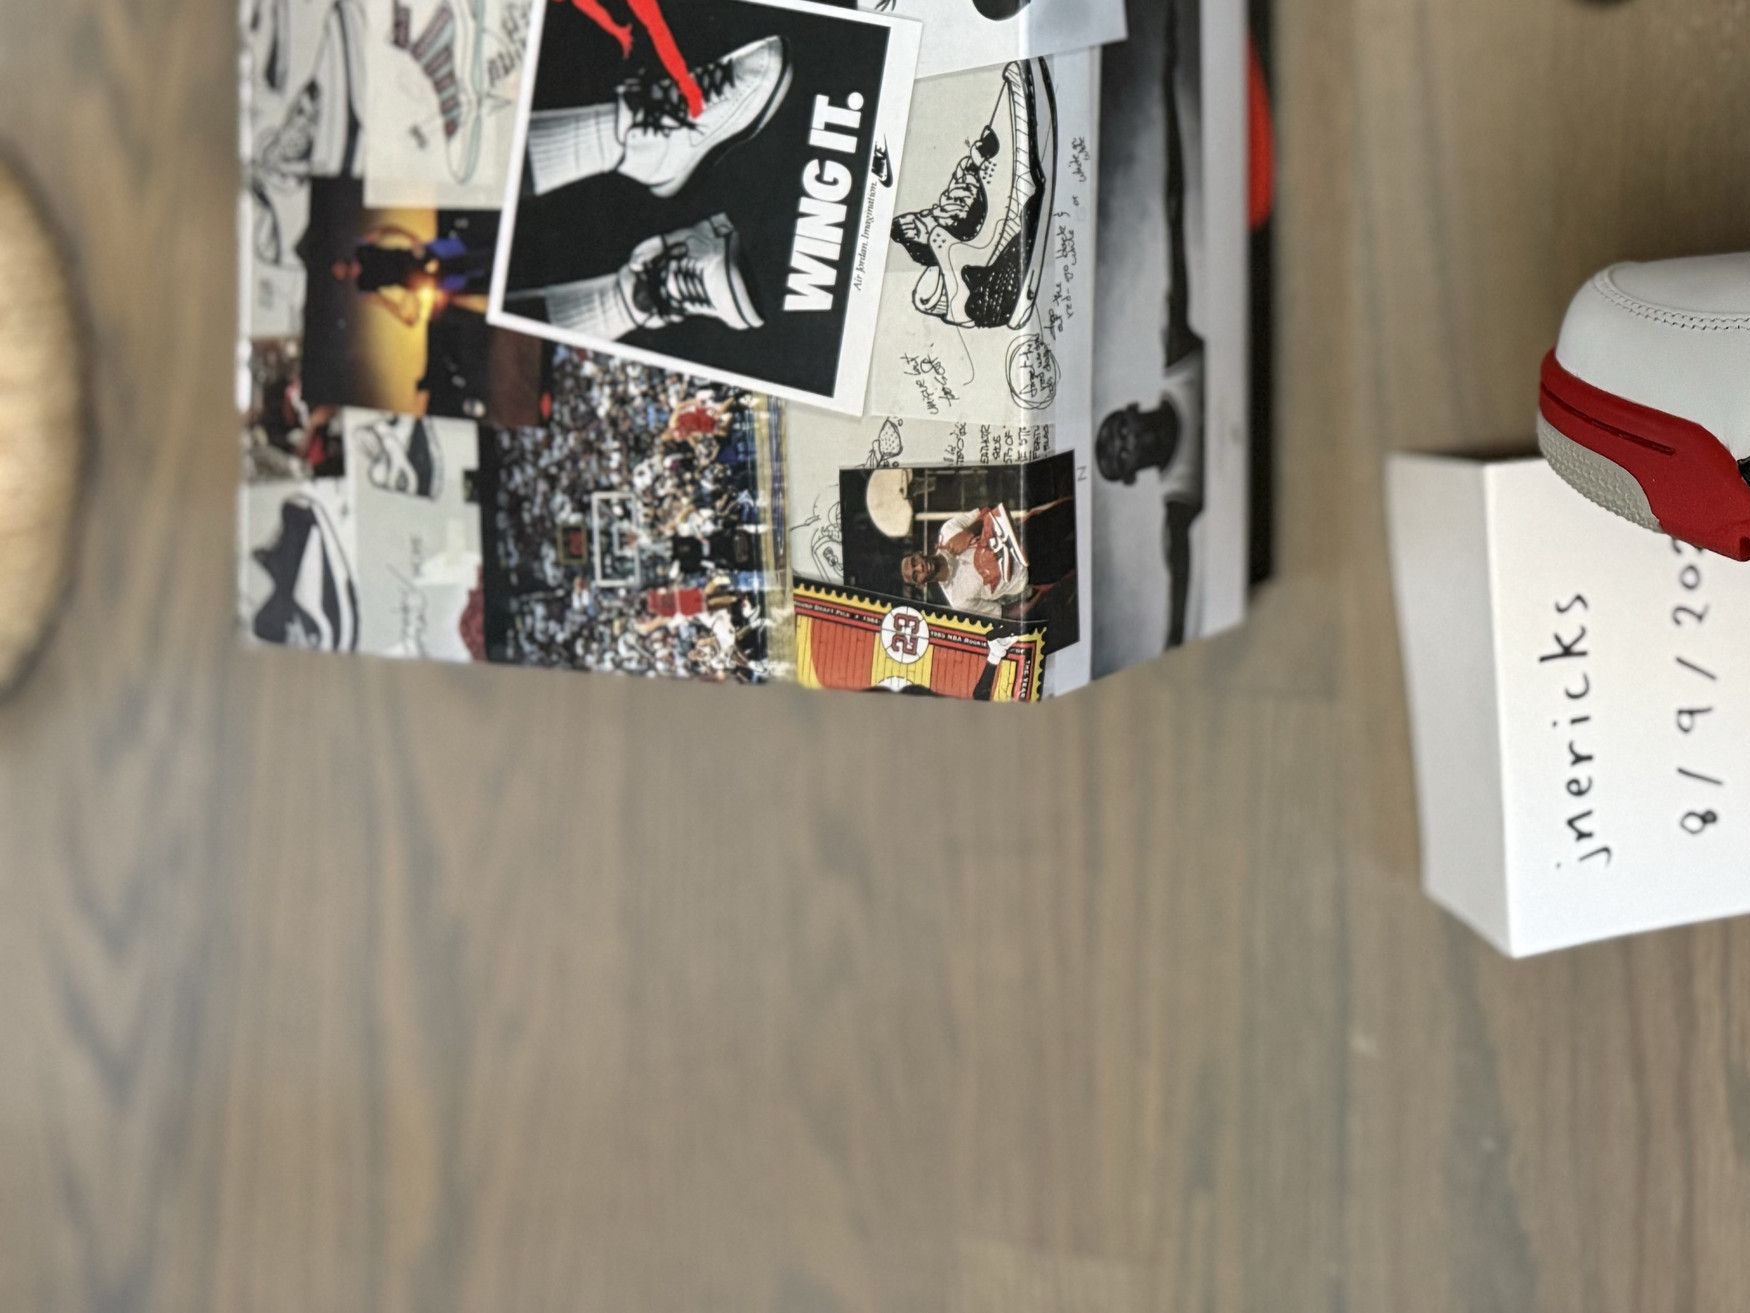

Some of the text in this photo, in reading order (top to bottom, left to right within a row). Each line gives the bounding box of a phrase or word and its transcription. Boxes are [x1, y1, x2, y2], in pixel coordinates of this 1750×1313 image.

[783, 92, 864, 312] WING IT.
[871, 146, 886, 179] NIKE
[853, 181, 878, 291] Air Jordan. Imagination.
[891, 612, 920, 656] 23
[1537, 591, 1613, 871] jnericks
